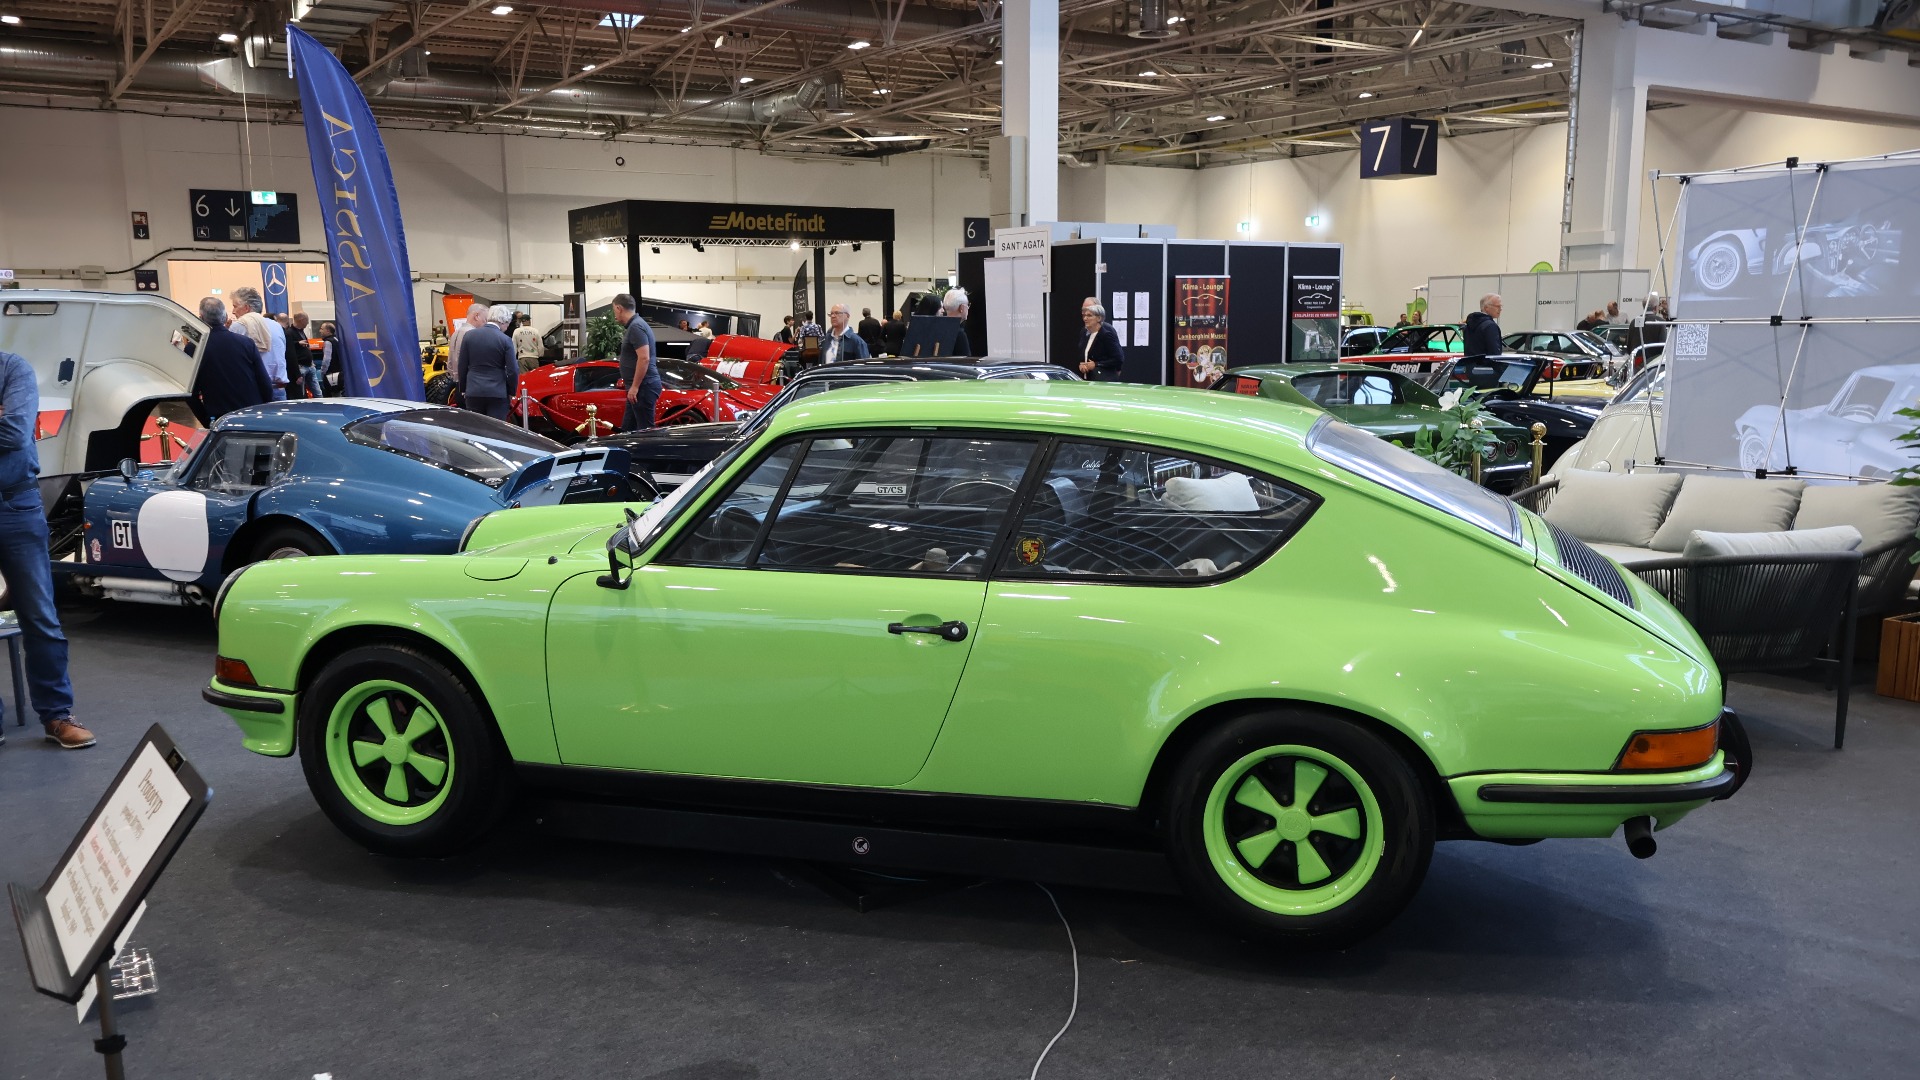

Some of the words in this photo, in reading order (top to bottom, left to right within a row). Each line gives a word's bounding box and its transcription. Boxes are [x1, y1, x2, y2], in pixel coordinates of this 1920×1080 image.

[1370, 125, 1391, 172] 7
[1410, 124, 1429, 169] 7
[196, 194, 210, 217] 6
[581, 210, 622, 233] Moetefindt
[722, 211, 826, 232] Moetefindt
[967, 221, 976, 239] 6
[1023, 239, 1045, 250] AGATA
[1391, 363, 1421, 373] Castrol
[877, 486, 904, 494] GT/CS
[113, 521, 130, 548] GT
[138, 768, 164, 821] Prototyp
